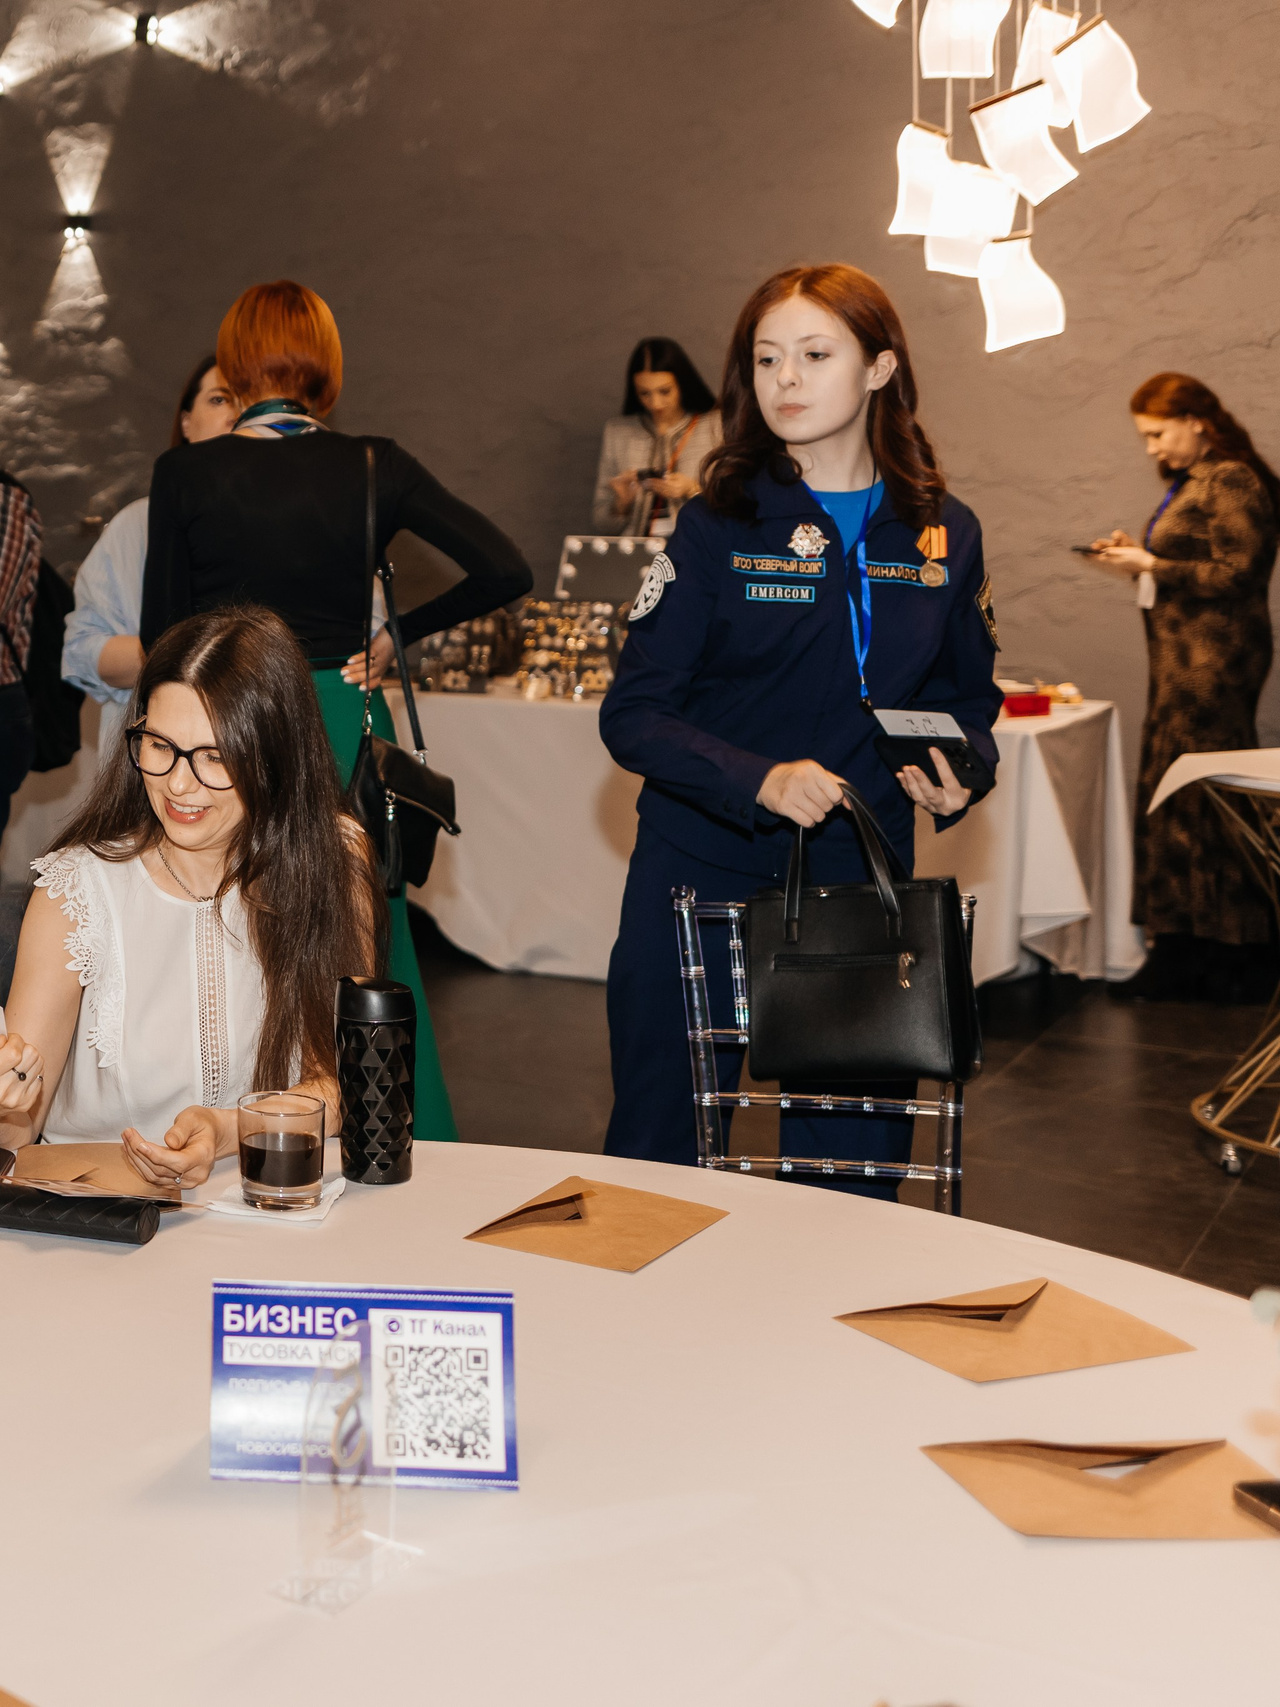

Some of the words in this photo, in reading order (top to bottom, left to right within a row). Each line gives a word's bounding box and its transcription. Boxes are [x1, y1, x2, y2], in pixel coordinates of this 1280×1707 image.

[732, 555, 752, 570] ВГСО
[750, 586, 810, 600] EMERCOM
[223, 1303, 358, 1336] БИЗНЕС
[410, 1319, 430, 1334] ТГ
[433, 1319, 488, 1338] Канал
[227, 1341, 313, 1361] ТУСОВКА
